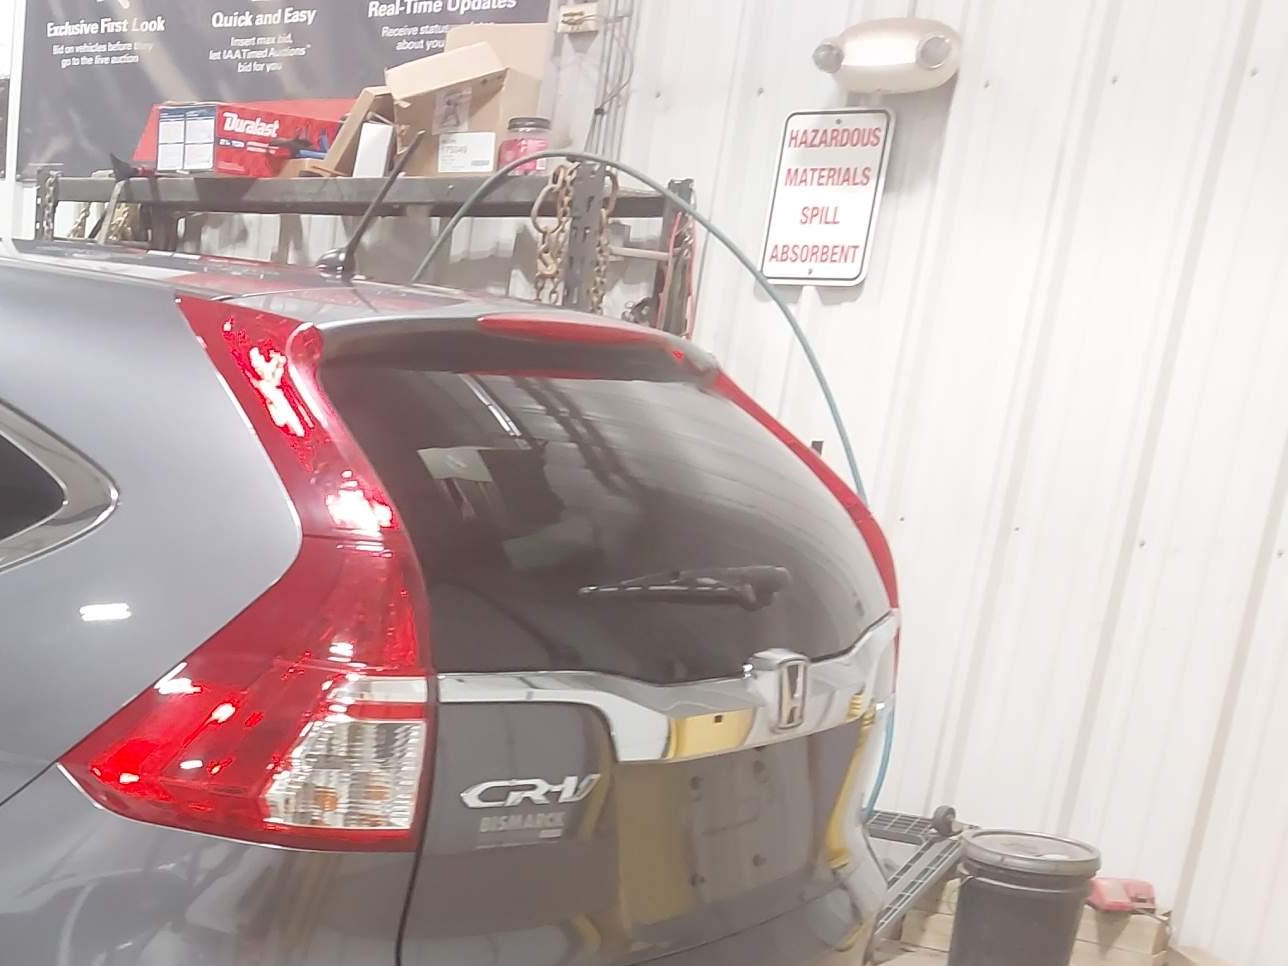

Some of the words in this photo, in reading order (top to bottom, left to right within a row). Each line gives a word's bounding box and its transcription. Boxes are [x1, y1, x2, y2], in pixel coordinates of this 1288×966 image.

[212, 11, 253, 27] Quick
[254, 9, 282, 25] and
[284, 7, 317, 25] Easy
[367, 0, 443, 17] Real-Time
[446, 0, 518, 15] Updates
[46, 19, 99, 37] Exclusive
[100, 17, 129, 34] First
[131, 16, 166, 32] Look
[381, 25, 419, 37] Receive
[396, 38, 424, 51] about
[237, 62, 252, 73] bid
[253, 61, 265, 72] for
[223, 112, 280, 138] Duralast
[787, 127, 882, 148] HAZARDOUS
[784, 166, 872, 187] MATERIALS
[800, 205, 840, 225] SPILL
[768, 243, 860, 264] ABSORBENT
[460, 773, 601, 809] CR-V
